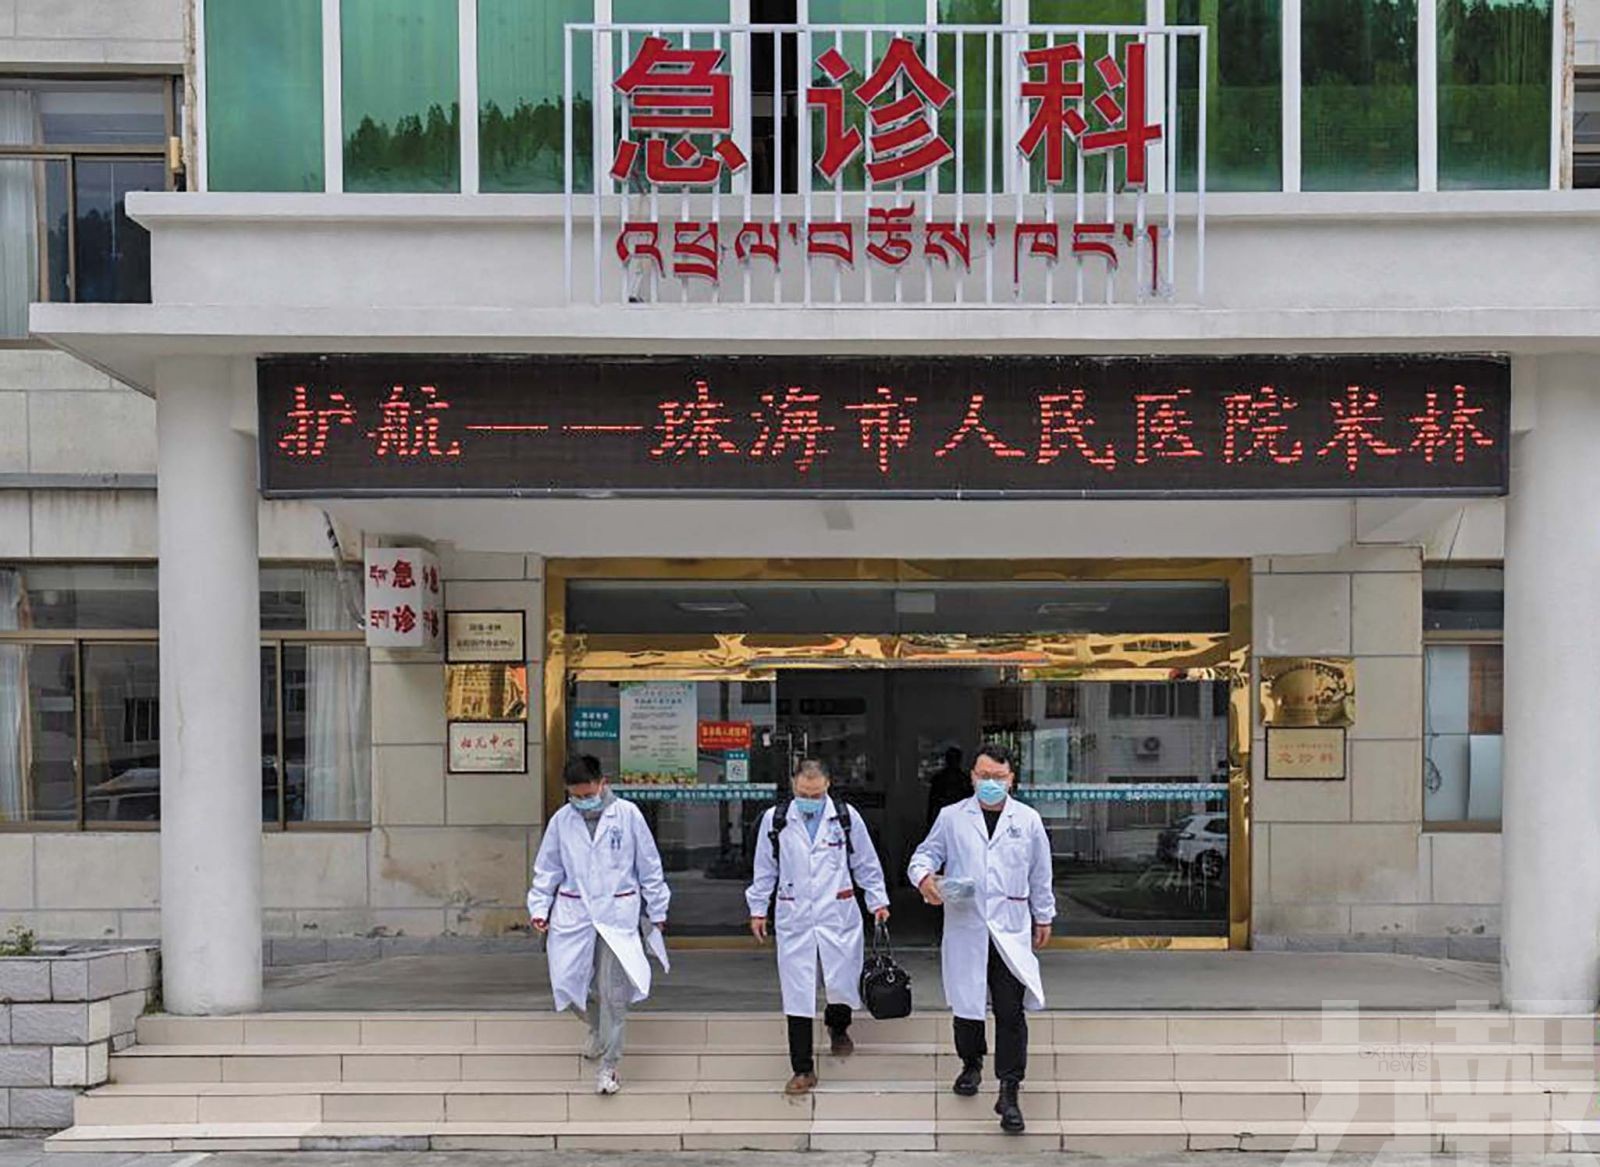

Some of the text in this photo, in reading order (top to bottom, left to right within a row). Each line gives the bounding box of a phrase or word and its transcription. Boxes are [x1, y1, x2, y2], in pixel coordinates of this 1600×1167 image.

[611, 36, 1163, 187] 急诊科
[392, 559, 417, 634] 急诊
